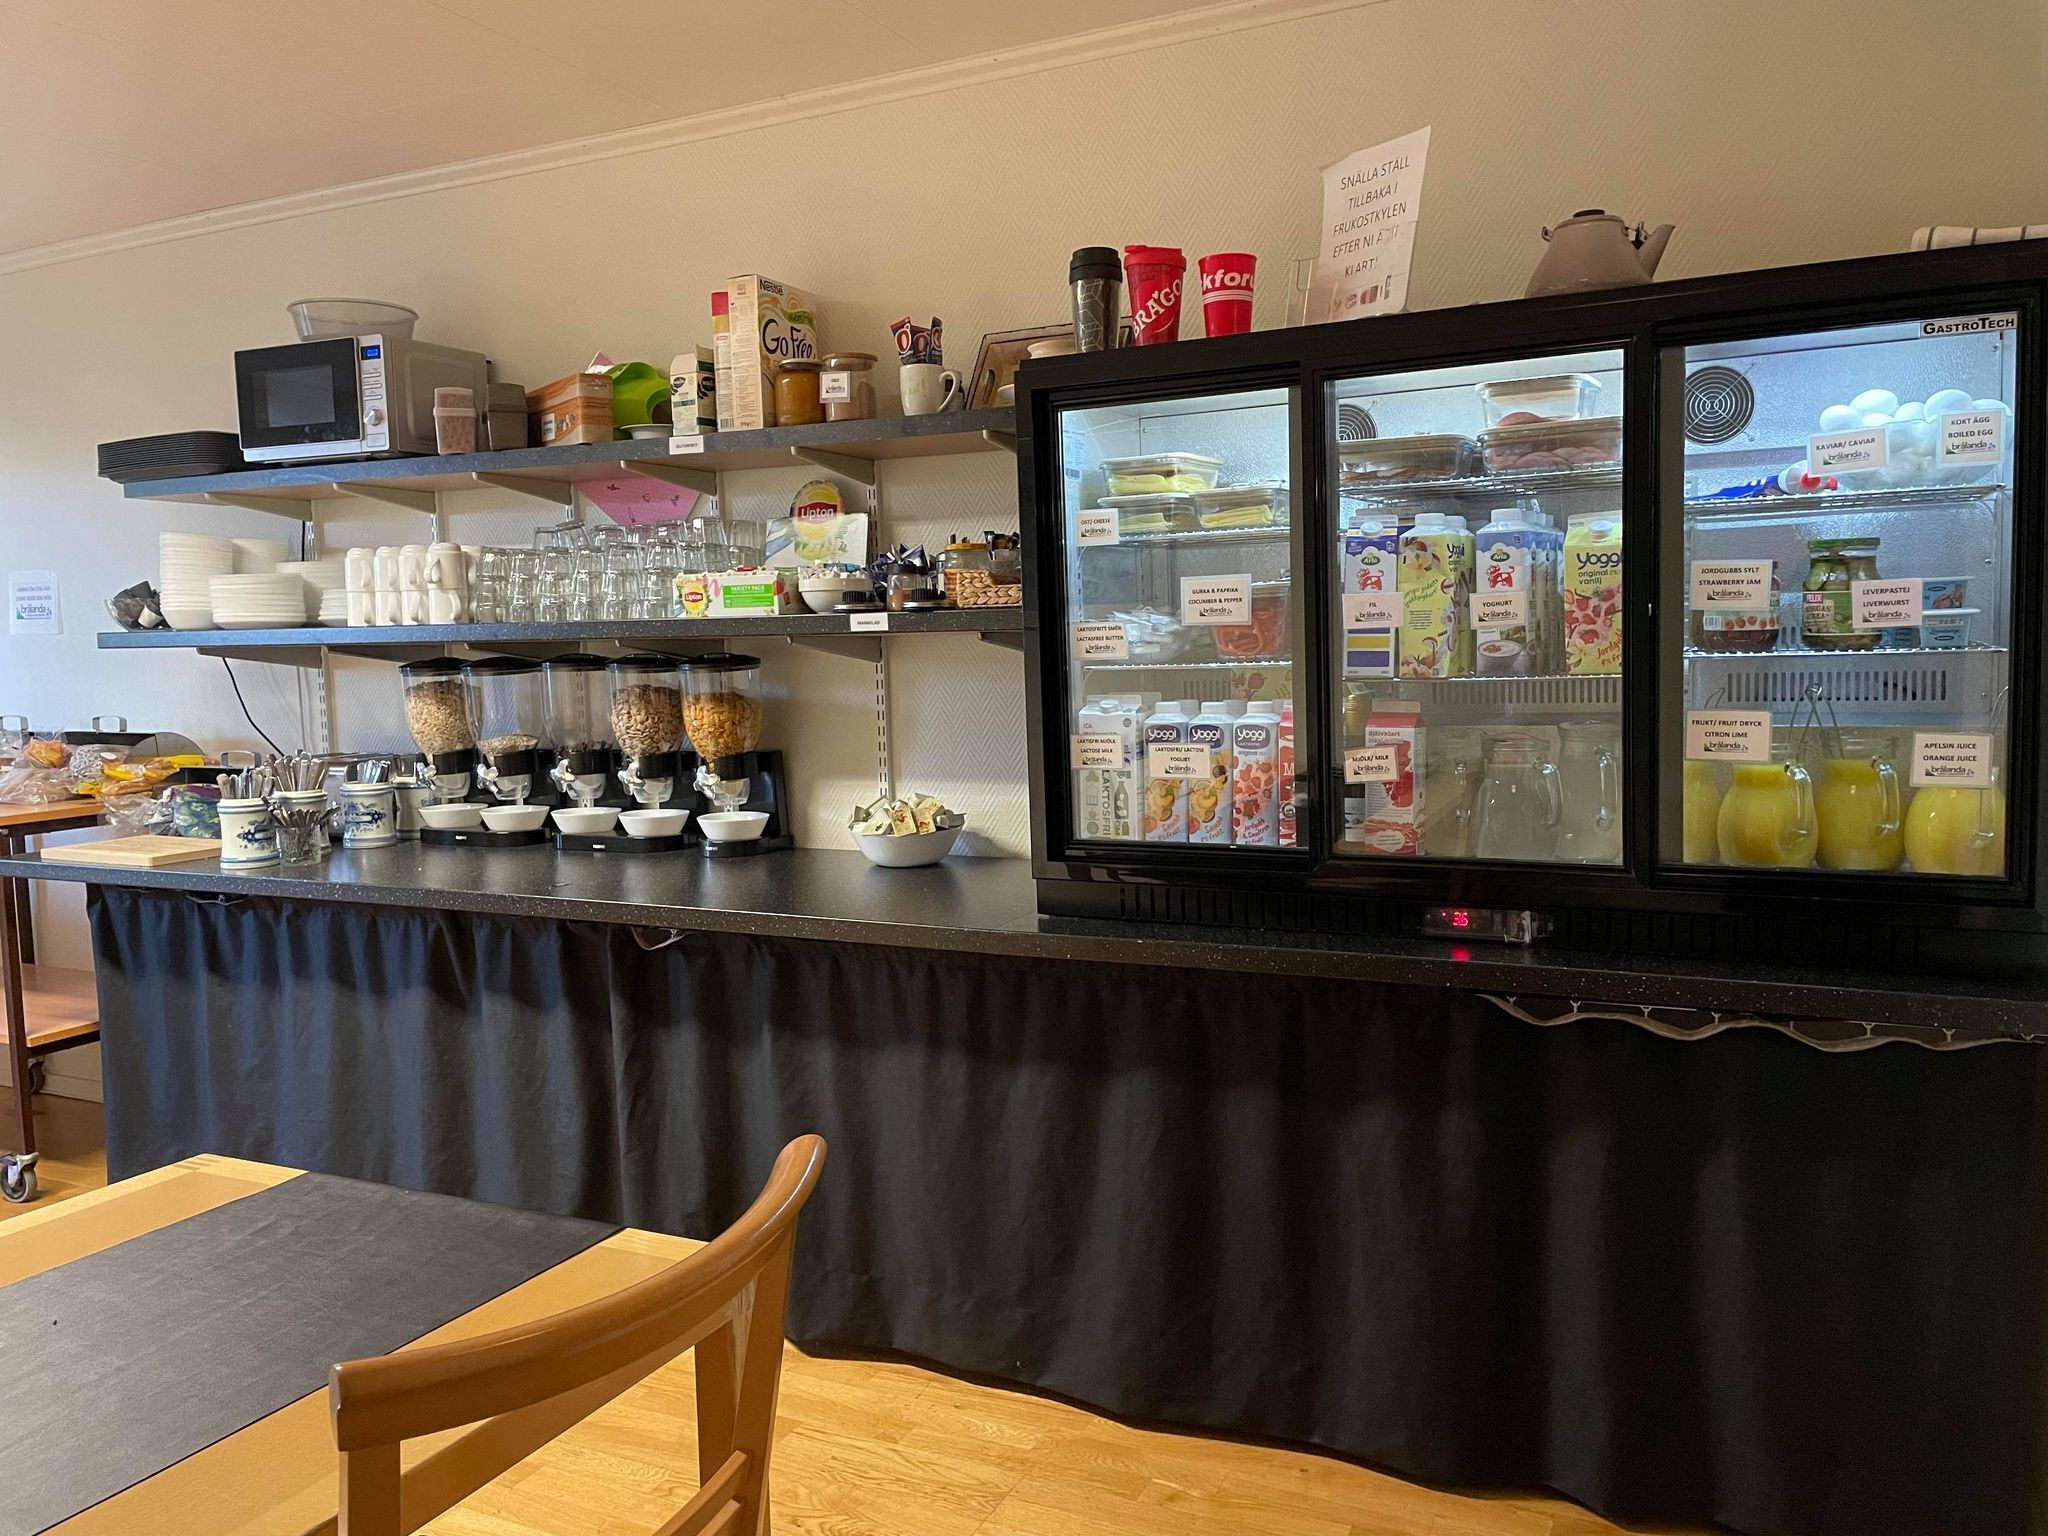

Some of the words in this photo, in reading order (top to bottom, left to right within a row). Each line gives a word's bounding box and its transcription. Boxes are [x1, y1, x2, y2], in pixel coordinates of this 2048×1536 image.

[1340, 167, 1378, 190] SNÄLLA
[1380, 155, 1410, 177] STÄLL
[1348, 185, 1393, 210] TILLBAKA
[1333, 201, 1407, 238] FRUKOSTKYLEN
[1332, 238, 1361, 259] EFTER
[1362, 231, 1375, 249] NI
[1951, 418, 1971, 426] KOKT
[1948, 430, 1976, 439] BOILED
[1977, 429, 1993, 437] EGG
[1848, 437, 1876, 447] CAVIAR
[801, 507, 834, 521] Lipton
[1578, 569, 1609, 578] original
[1862, 586, 1911, 595] LEVERPASTEJ
[1863, 599, 1910, 607] LIVERWURST
[1691, 719, 1717, 727] FRUKT/
[1148, 728, 1177, 741] yoggi
[1191, 728, 1220, 741] yoggi
[1237, 728, 1266, 741] yoggi
